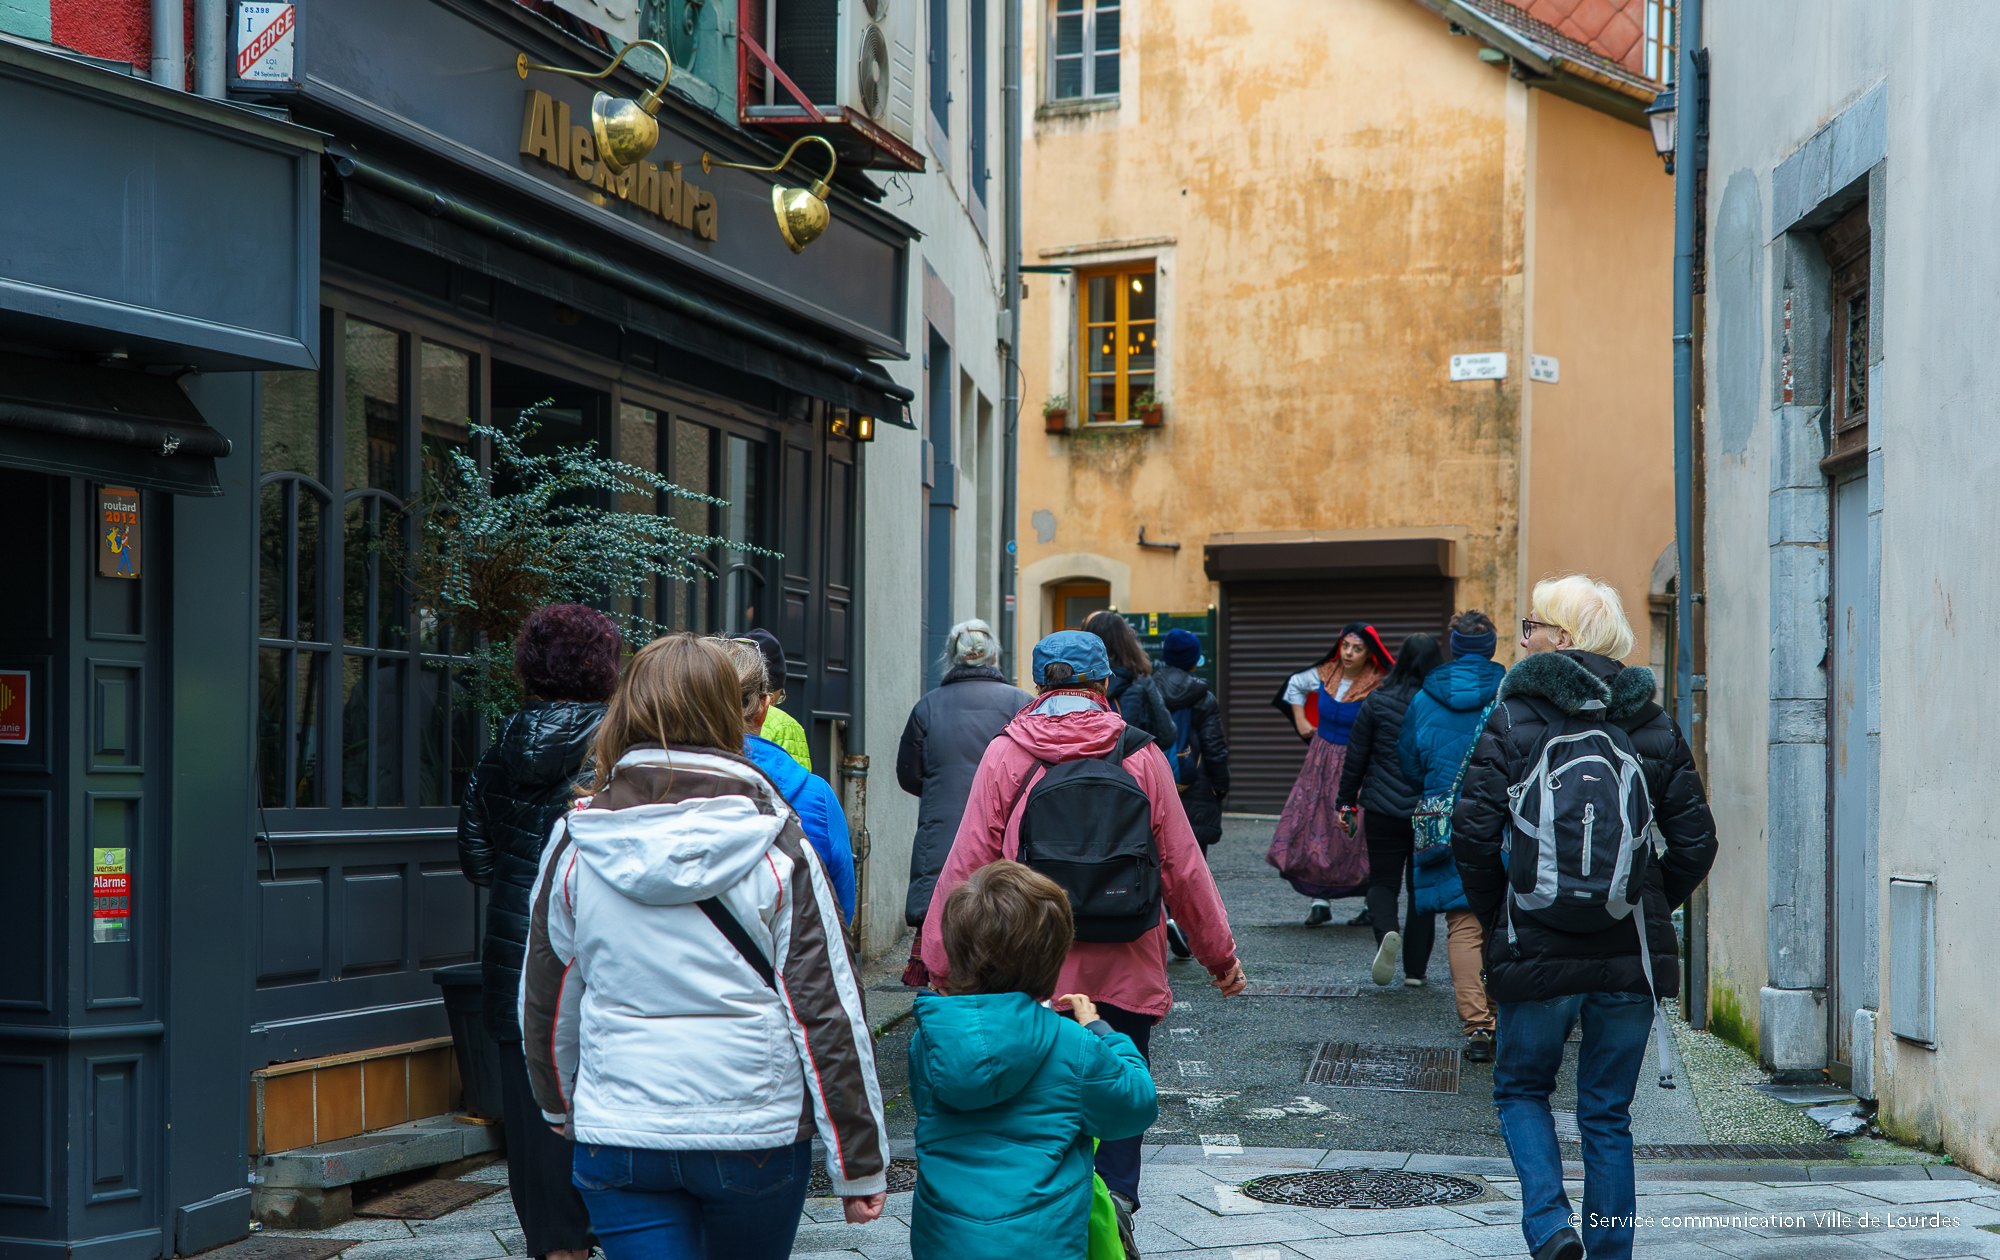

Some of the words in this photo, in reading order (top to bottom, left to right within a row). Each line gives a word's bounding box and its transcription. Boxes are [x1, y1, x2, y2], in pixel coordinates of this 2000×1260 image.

[246, 18, 253, 32] I
[240, 9, 292, 72] LICENCE
[104, 502, 136, 512] routard
[106, 510, 136, 524] 2012
[94, 876, 126, 888] Alarme
